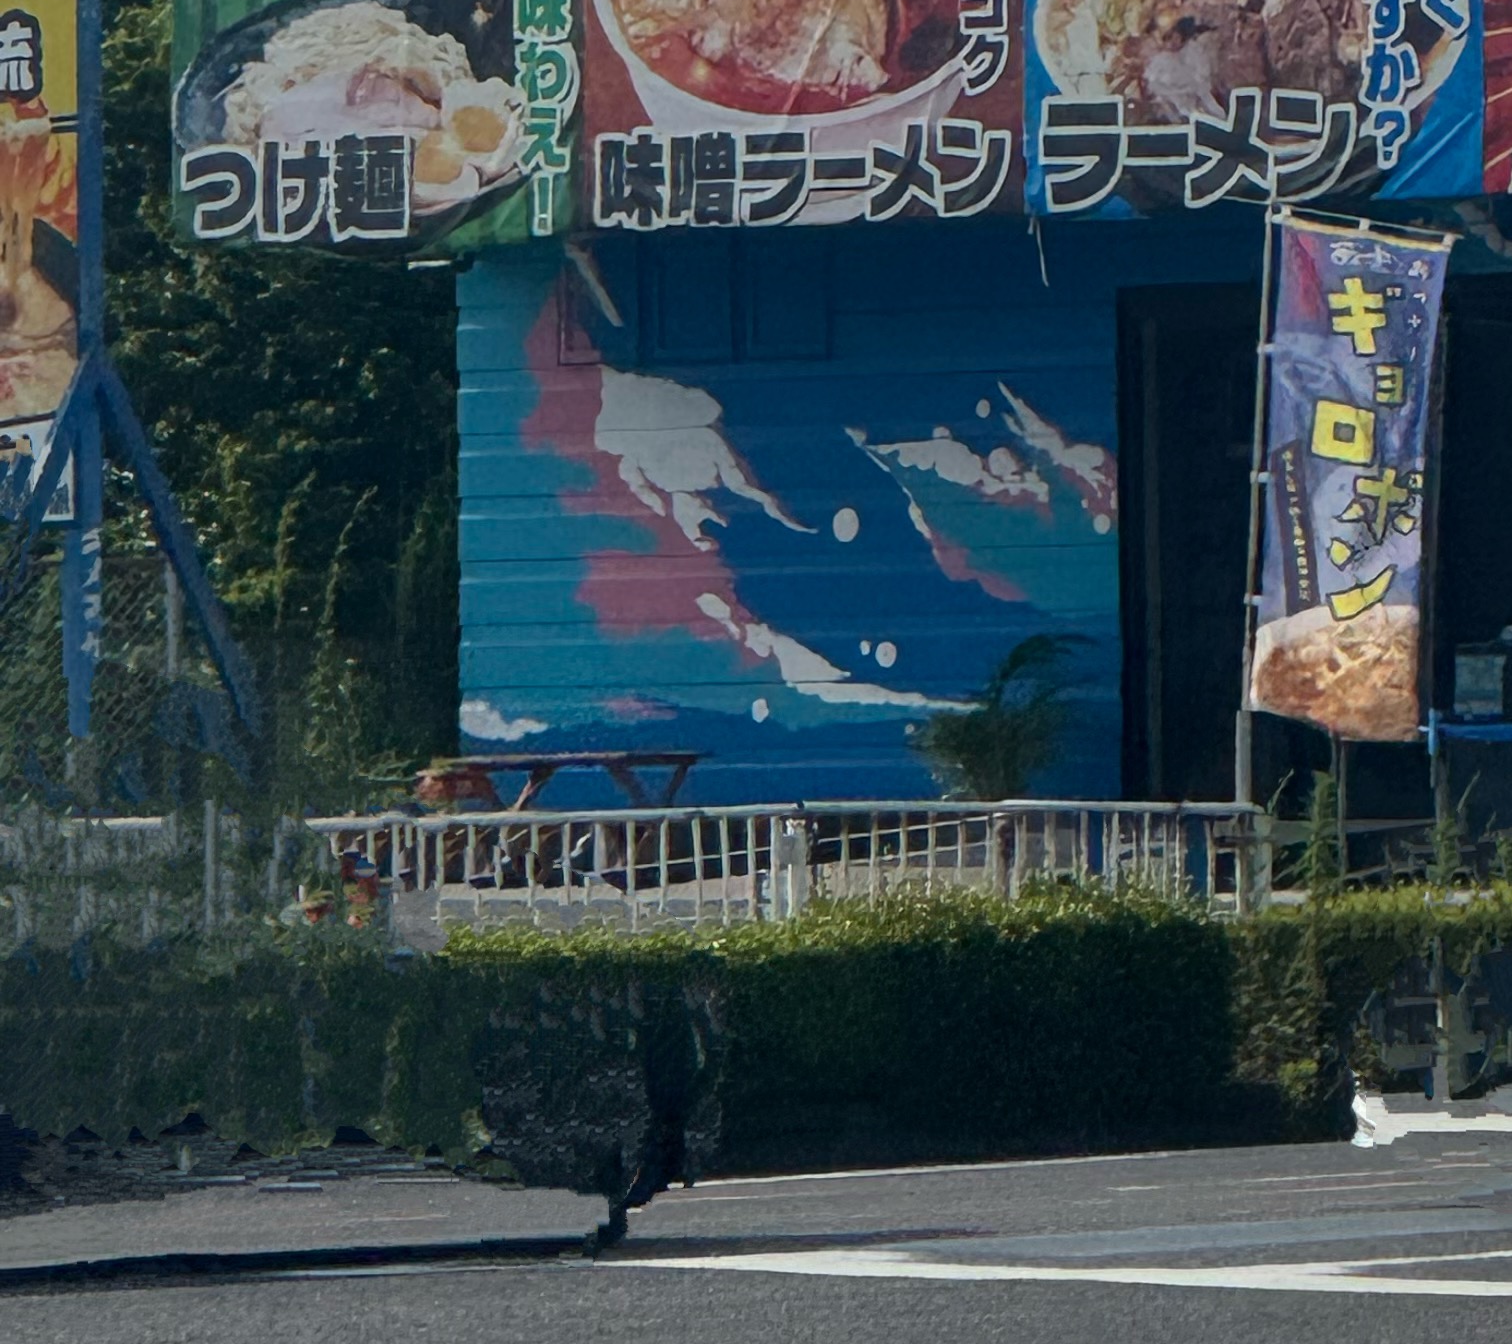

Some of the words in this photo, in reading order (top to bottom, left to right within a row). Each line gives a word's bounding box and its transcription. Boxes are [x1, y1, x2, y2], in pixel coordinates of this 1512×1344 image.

[180, 133, 411, 242] つけ麺
[595, 117, 1011, 231] 味噌ラーメン
[1039, 87, 1357, 212] ラーメン
